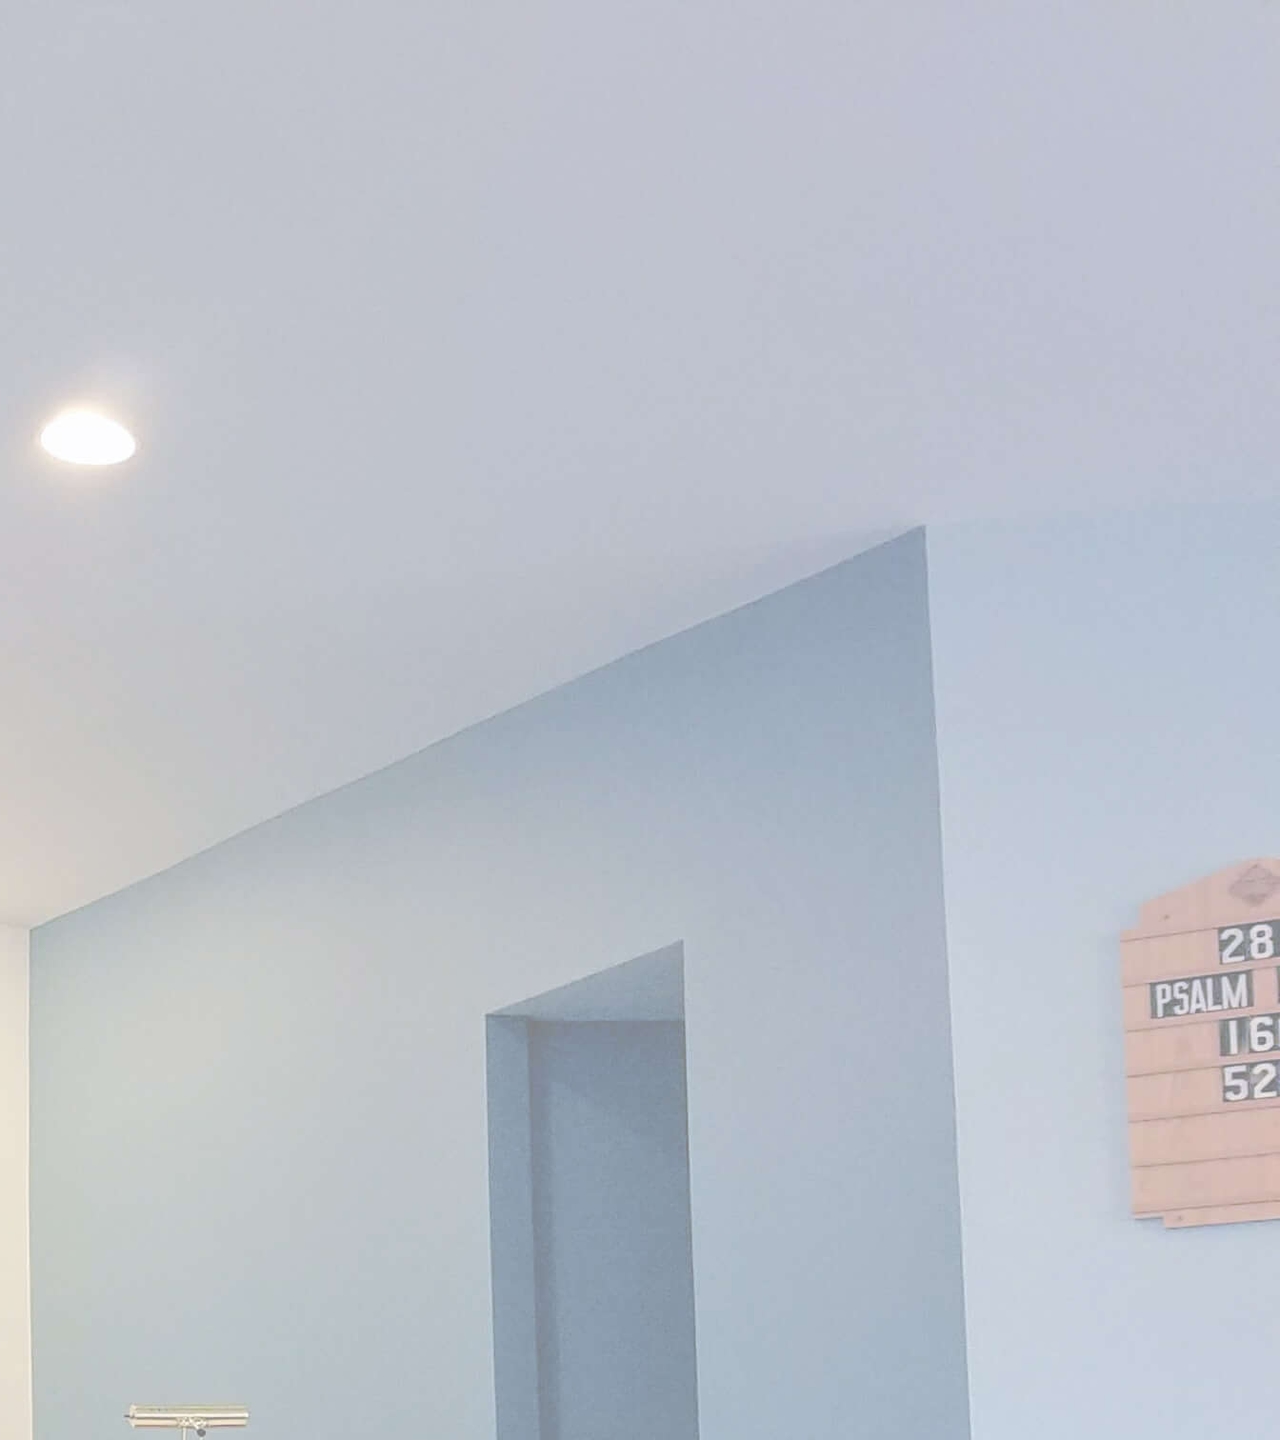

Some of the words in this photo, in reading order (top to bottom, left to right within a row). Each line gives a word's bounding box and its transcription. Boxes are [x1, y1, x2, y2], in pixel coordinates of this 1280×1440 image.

[1219, 923, 1274, 964] 28
[1155, 973, 1248, 1018] PSALM
[1229, 1016, 1280, 1055] 16
[1223, 1062, 1278, 1101] 52
